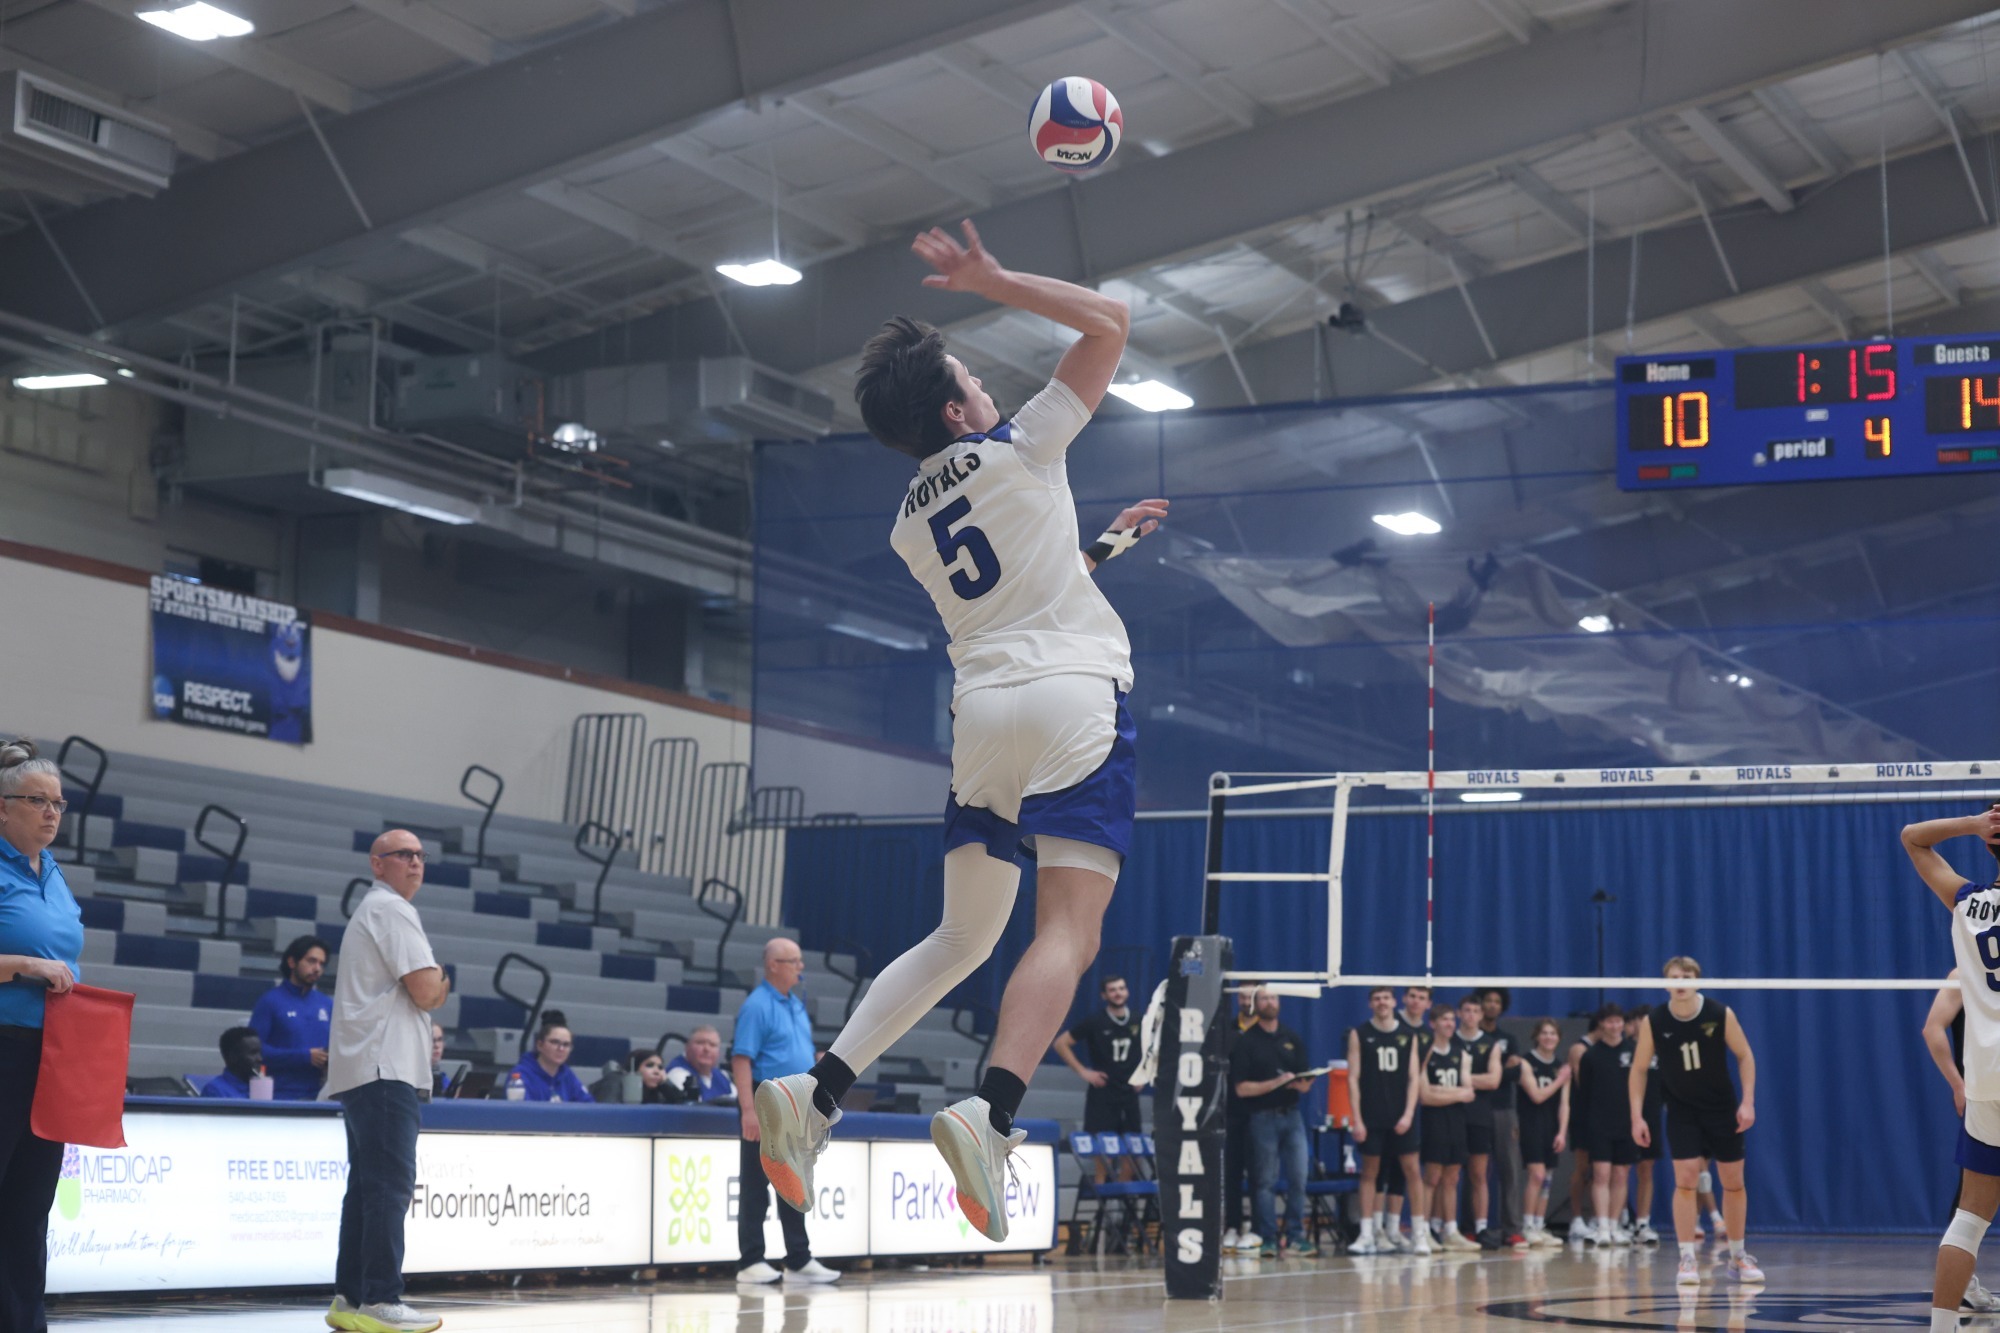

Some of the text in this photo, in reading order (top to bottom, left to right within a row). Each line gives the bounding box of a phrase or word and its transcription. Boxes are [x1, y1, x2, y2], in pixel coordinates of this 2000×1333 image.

[1935, 344, 1990, 364] Guests
[1646, 362, 1690, 383] Home
[1961, 376, 2000, 430] 14
[1663, 391, 1709, 448] 10
[1773, 437, 1826, 462] period
[1864, 417, 1891, 456] 4
[904, 452, 981, 519] ROYALS
[927, 495, 1001, 601] 5
[150, 575, 298, 624] SPORTSMANSHIP
[1467, 771, 1519, 784] ROYALS
[1600, 769, 1654, 783] ROYALS
[1737, 767, 1792, 780] ROYALS
[1876, 763, 1933, 777] ROYALS
[1976, 925, 2000, 992] 9
[1112, 1038, 1131, 1062] 17
[1377, 1046, 1398, 1072] 10
[1680, 1040, 1701, 1071] 11
[1435, 1067, 1458, 1087] 30
[1177, 1008, 1205, 1264] ROYALS
[83, 1155, 172, 1184] MEDICAP
[228, 1160, 349, 1180] FREE DELIVERY
[84, 1188, 143, 1203] PHARMACY
[892, 1170, 945, 1221] Park
